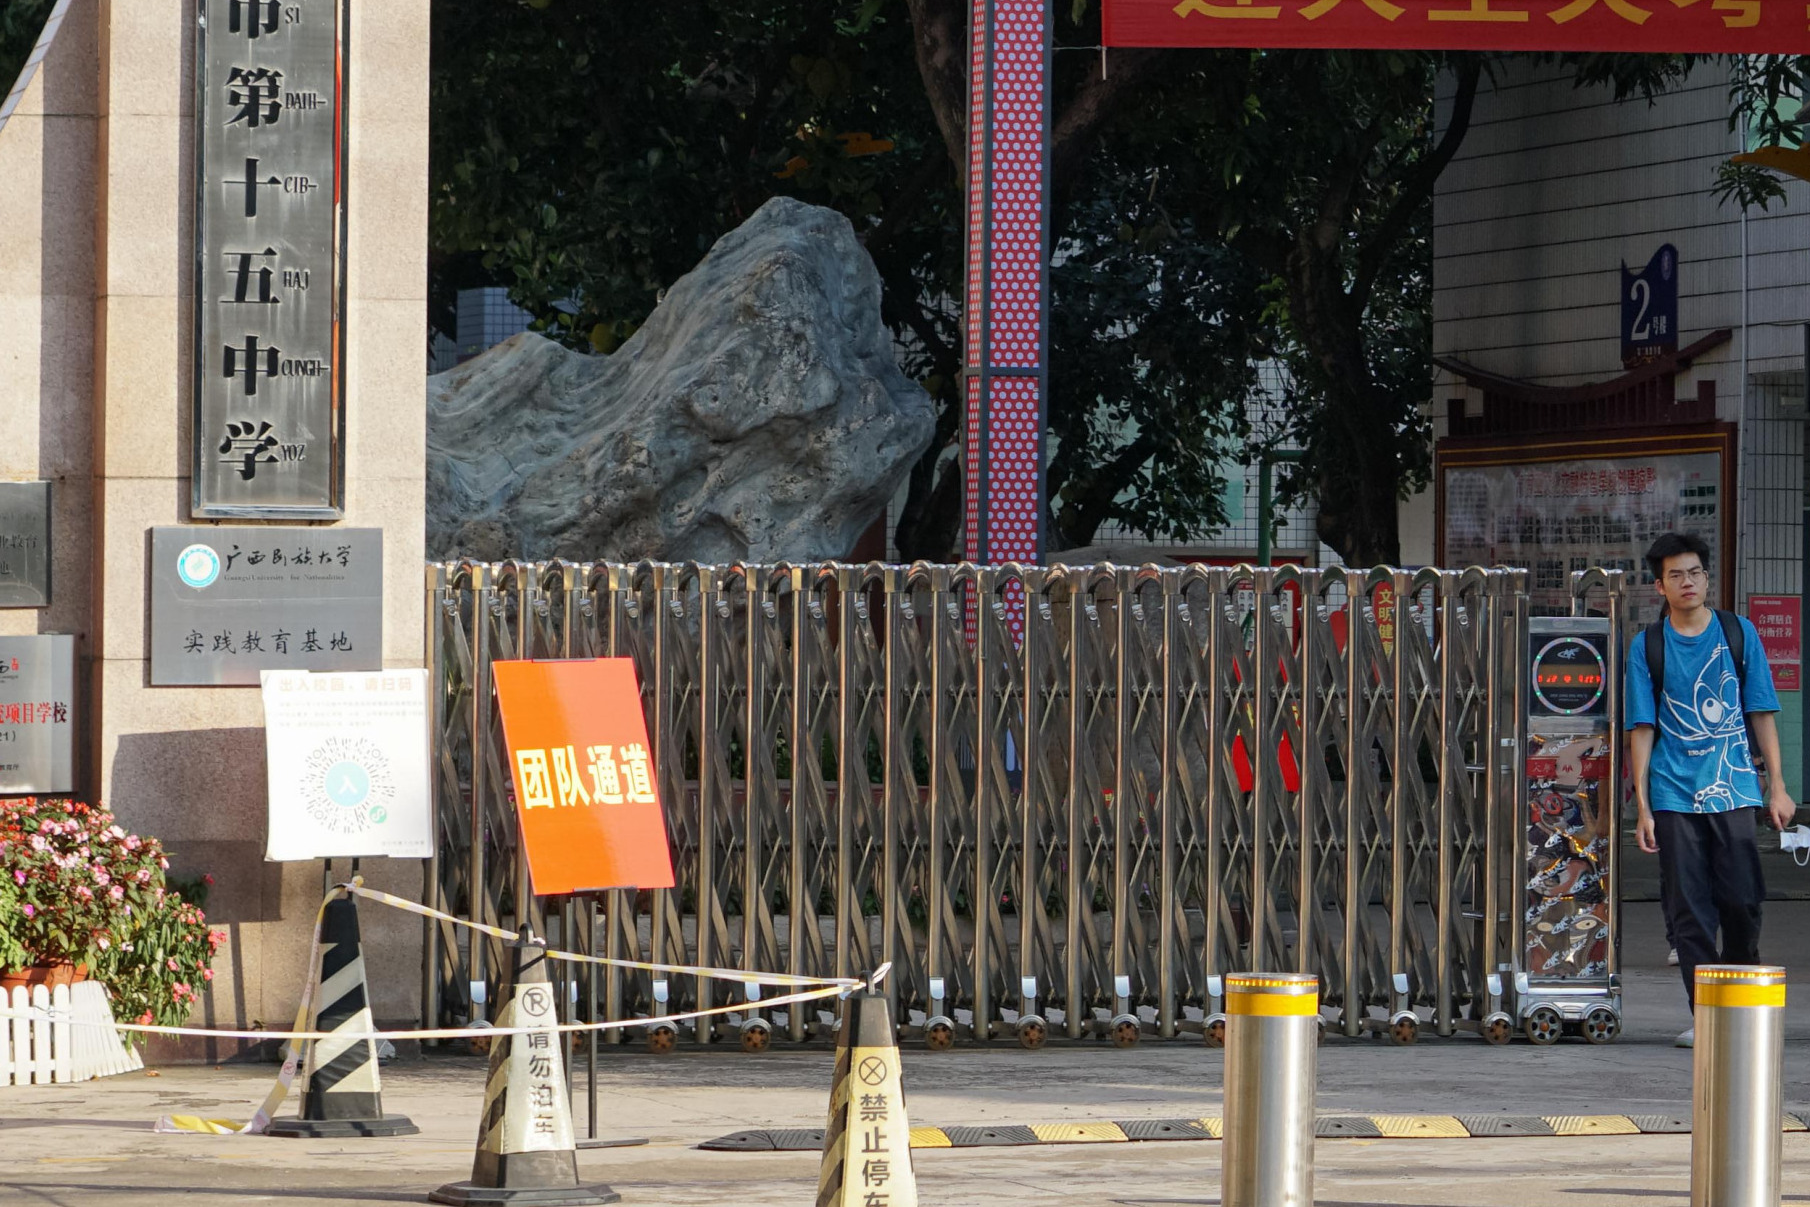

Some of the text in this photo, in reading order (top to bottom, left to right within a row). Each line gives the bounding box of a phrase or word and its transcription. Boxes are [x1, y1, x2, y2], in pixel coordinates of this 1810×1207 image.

[285, 6, 301, 25] SI
[280, 444, 306, 463] YOZ
[183, 629, 353, 655] 实践教育基地
[515, 742, 656, 810] 团队通道
